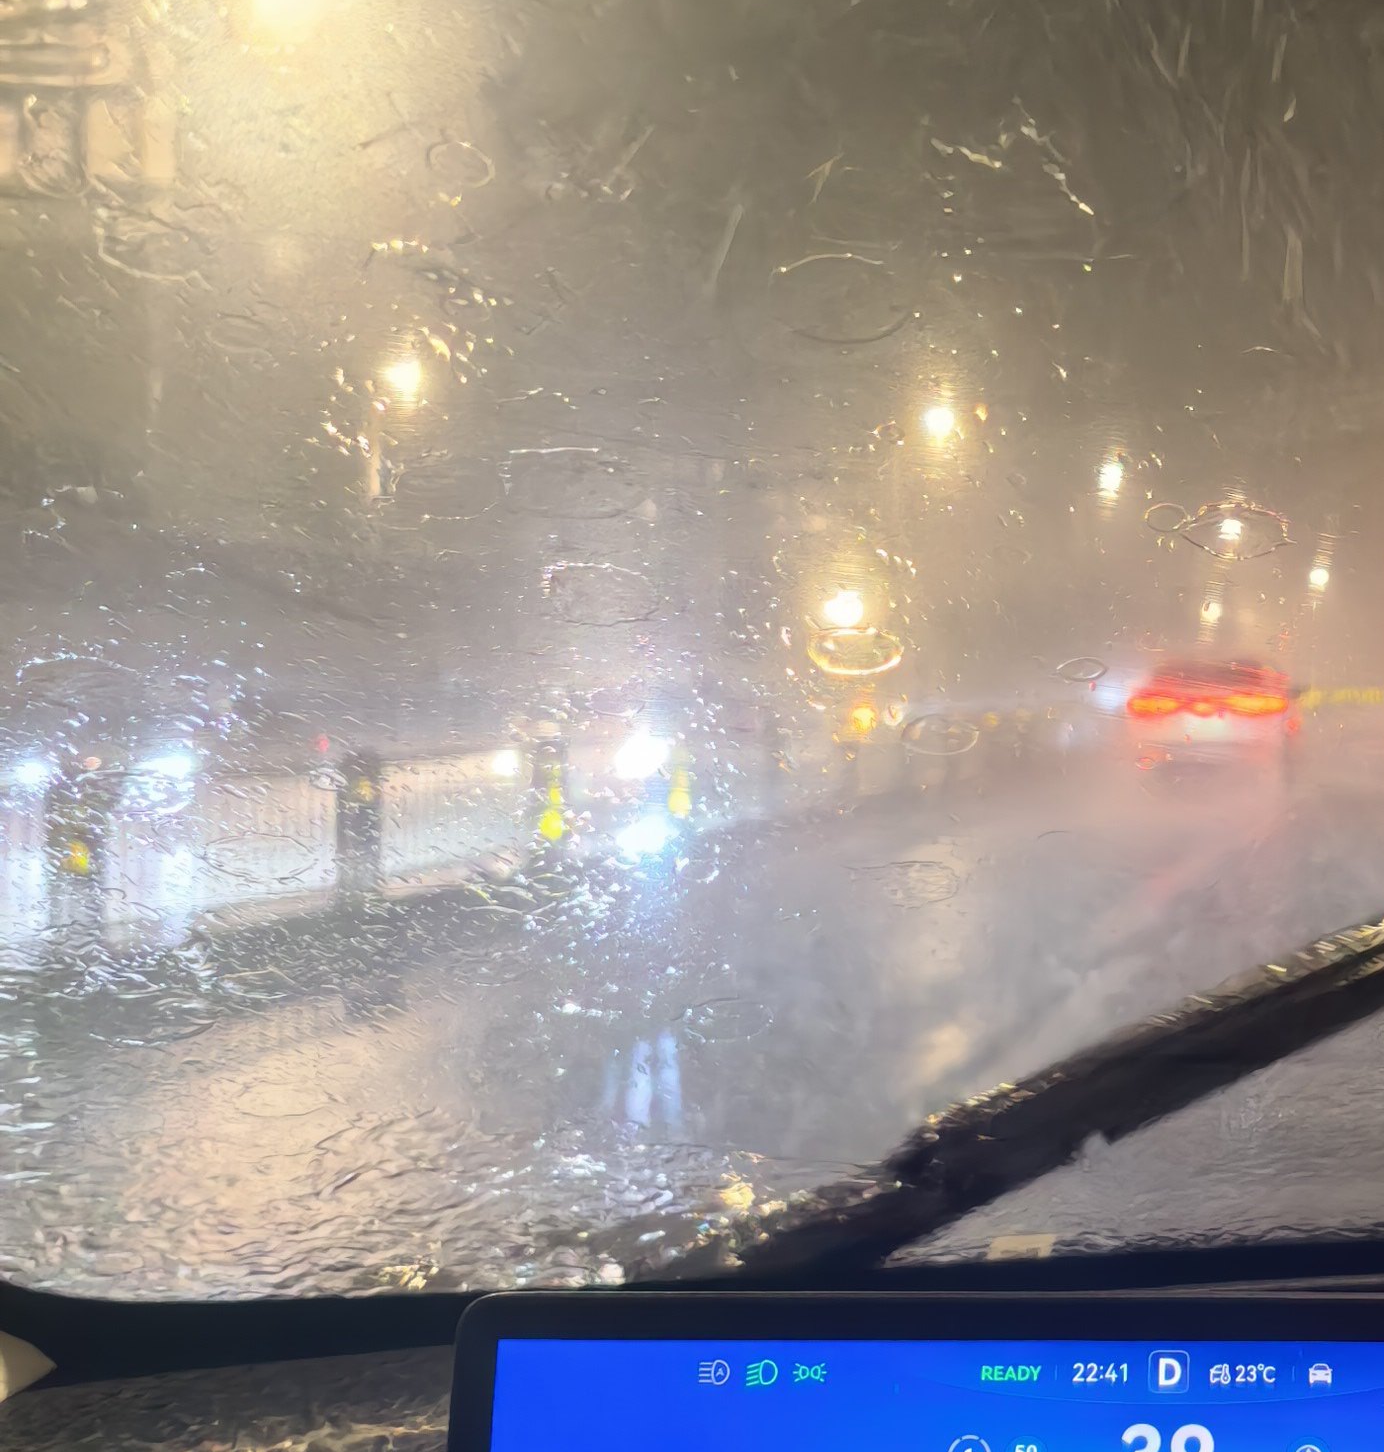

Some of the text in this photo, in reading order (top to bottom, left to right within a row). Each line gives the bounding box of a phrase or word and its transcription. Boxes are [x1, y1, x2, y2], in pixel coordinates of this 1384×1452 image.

[981, 1364, 1042, 1381] READY
[1071, 1362, 1129, 1384] 22:41
[1158, 1357, 1182, 1386] D
